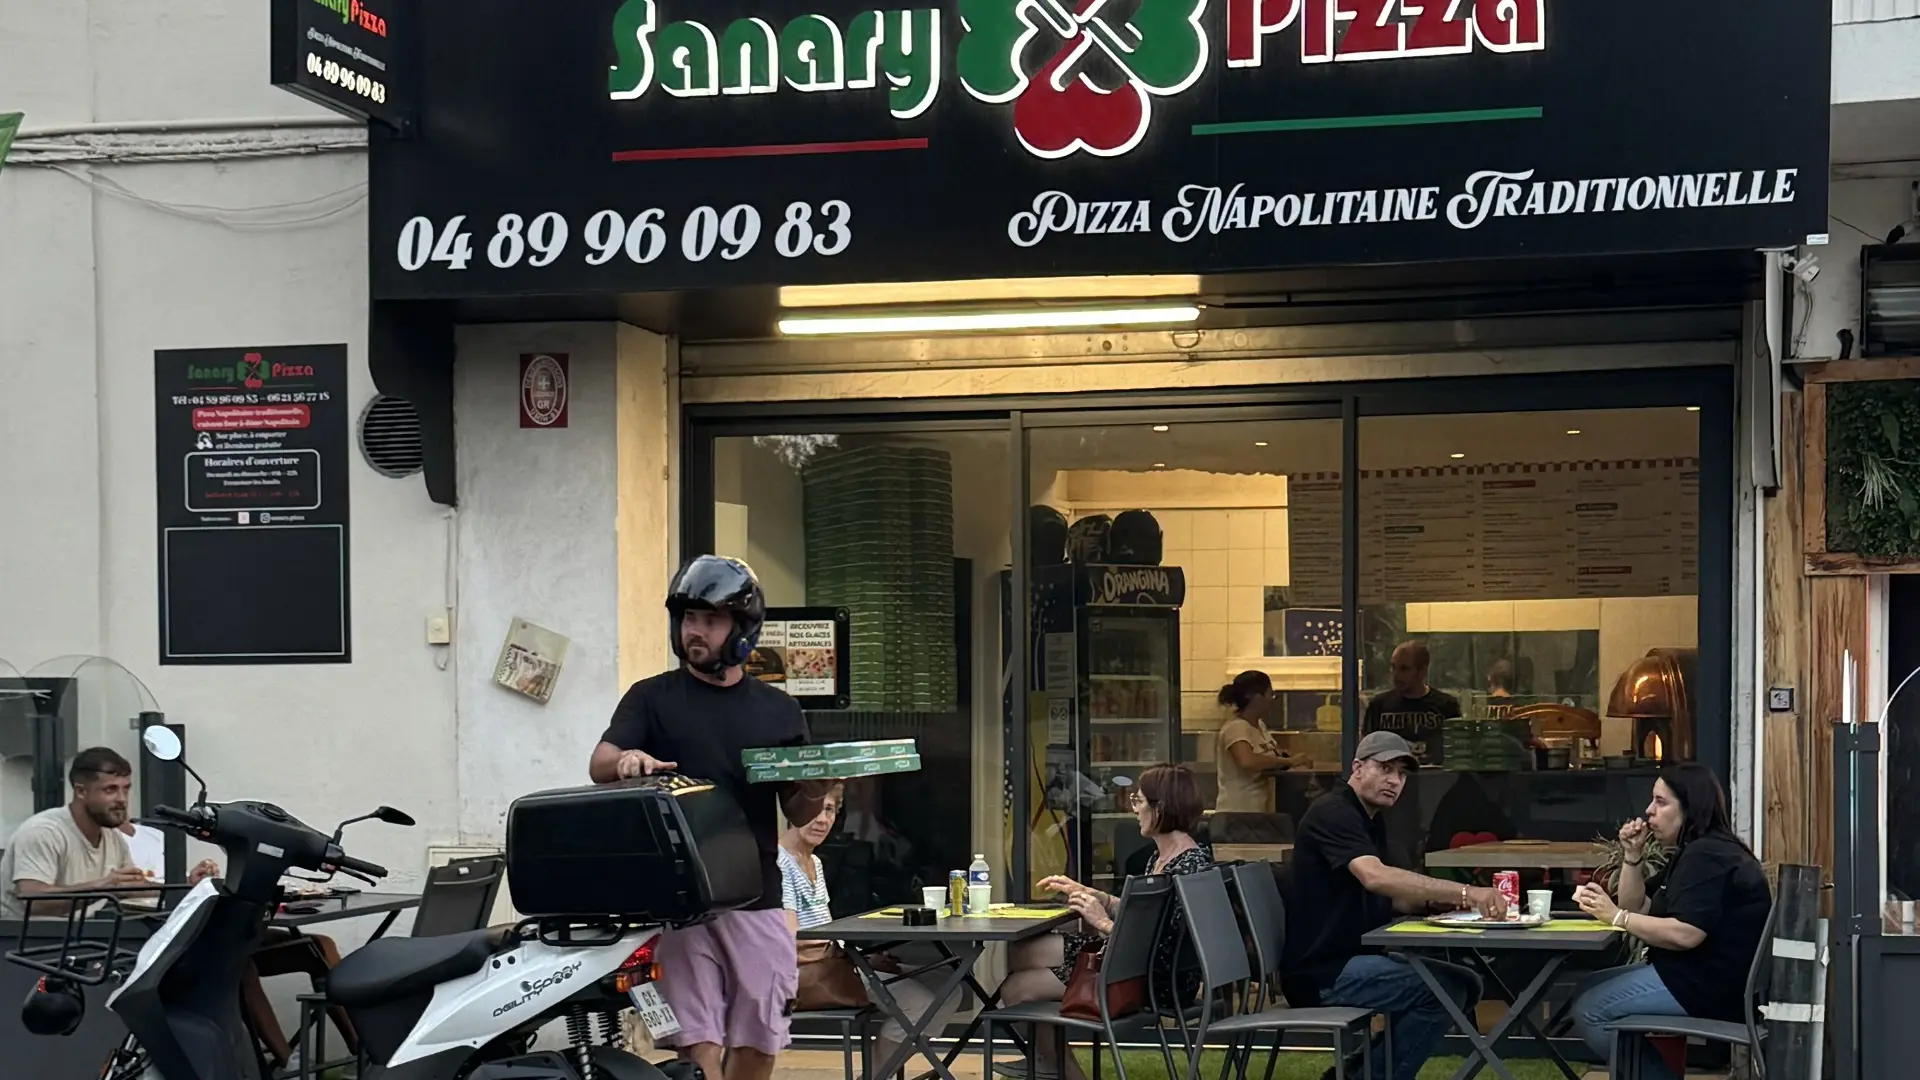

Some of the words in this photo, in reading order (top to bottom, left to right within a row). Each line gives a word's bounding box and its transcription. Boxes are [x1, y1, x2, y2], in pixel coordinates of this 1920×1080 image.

[306, 52, 323, 77] 04
[323, 59, 340, 84] 89
[339, 67, 355, 91] 96
[356, 74, 371, 97] 09
[370, 81, 386, 104] 83
[608, 0, 941, 119] Sanary
[1008, 191, 1150, 246] PIZZA
[1162, 183, 1440, 242] NAPOLITAINE
[1447, 169, 1797, 229] TRADITIONNELLE
[397, 216, 473, 271] 04
[487, 212, 569, 269] 89
[583, 208, 667, 265] 96
[681, 204, 762, 262] 09
[774, 200, 852, 257] 83
[187, 364, 235, 382] Sanary
[271, 362, 314, 378] Pizza
[204, 457, 245, 467] Horaires
[245, 456, 300, 466] d'ouverture
[1103, 568, 1169, 601] ORANGINA
